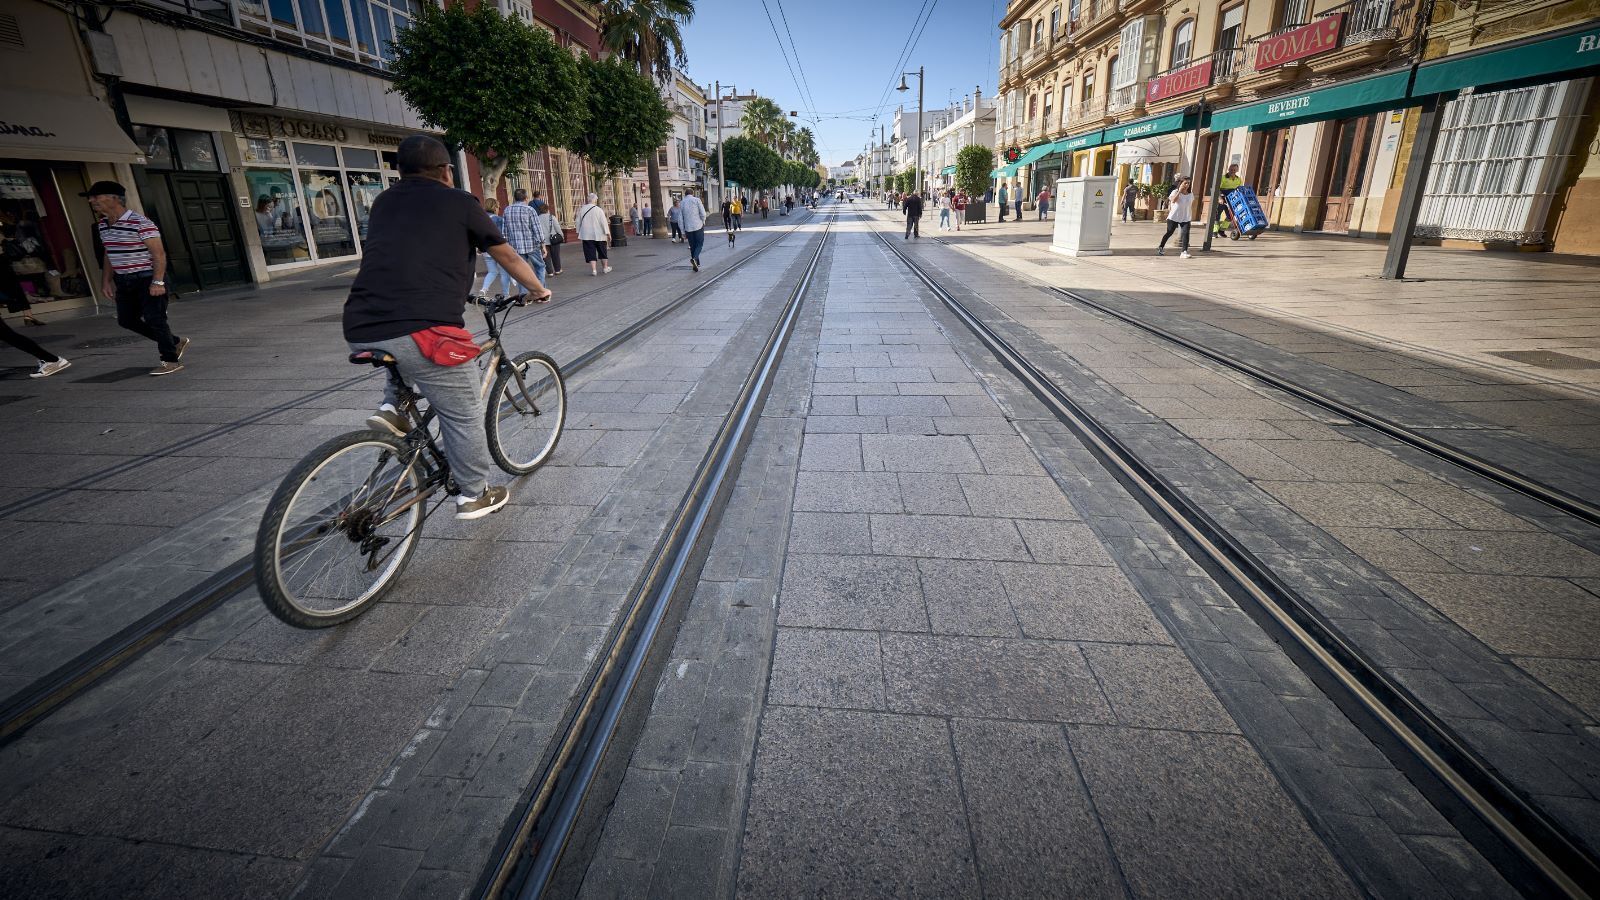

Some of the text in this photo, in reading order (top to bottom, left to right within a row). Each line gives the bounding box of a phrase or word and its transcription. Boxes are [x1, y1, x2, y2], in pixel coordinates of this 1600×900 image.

[1163, 66, 1205, 95] HOTEL
[1268, 96, 1311, 113] REVERTE
[280, 119, 346, 142] OCASO
[1123, 123, 1152, 137] AZABACHE
